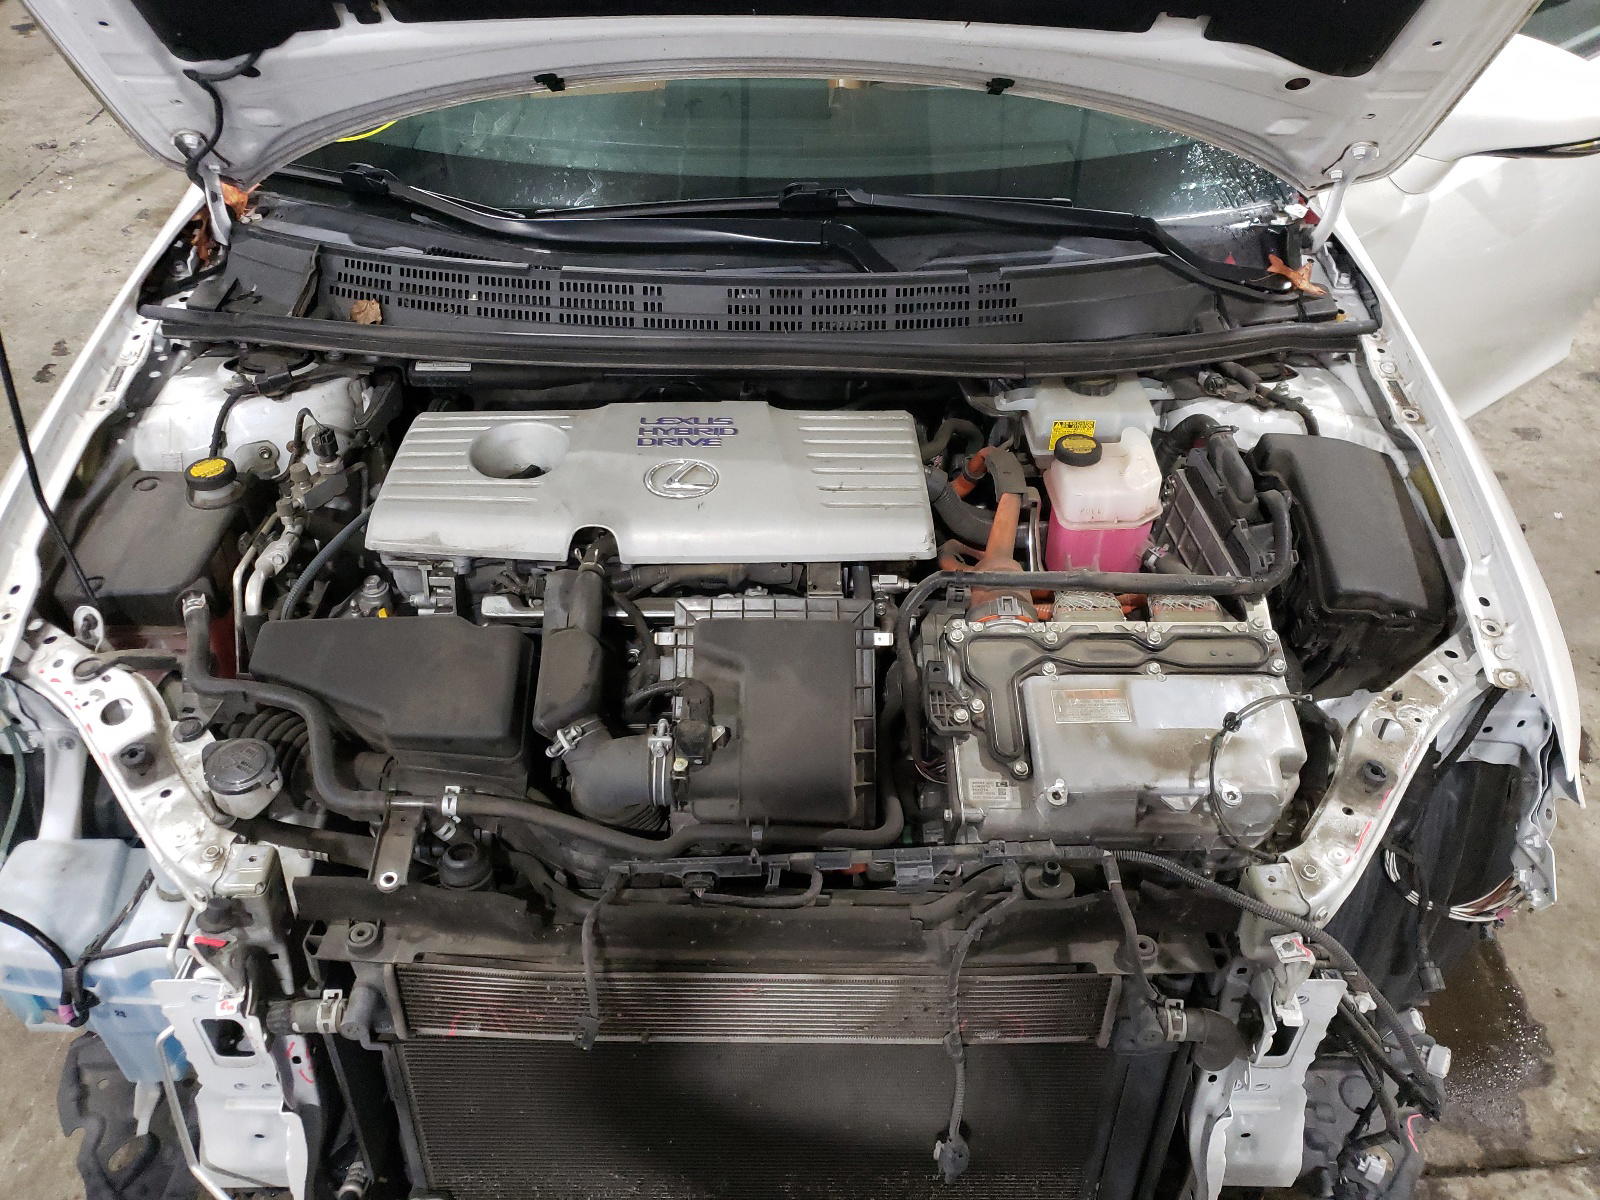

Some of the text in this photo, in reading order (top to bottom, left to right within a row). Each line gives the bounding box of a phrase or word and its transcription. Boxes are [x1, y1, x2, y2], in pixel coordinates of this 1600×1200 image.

[640, 417, 734, 425] LEXUS
[638, 427, 739, 436] HYBRID
[637, 437, 722, 447] DRIVE
